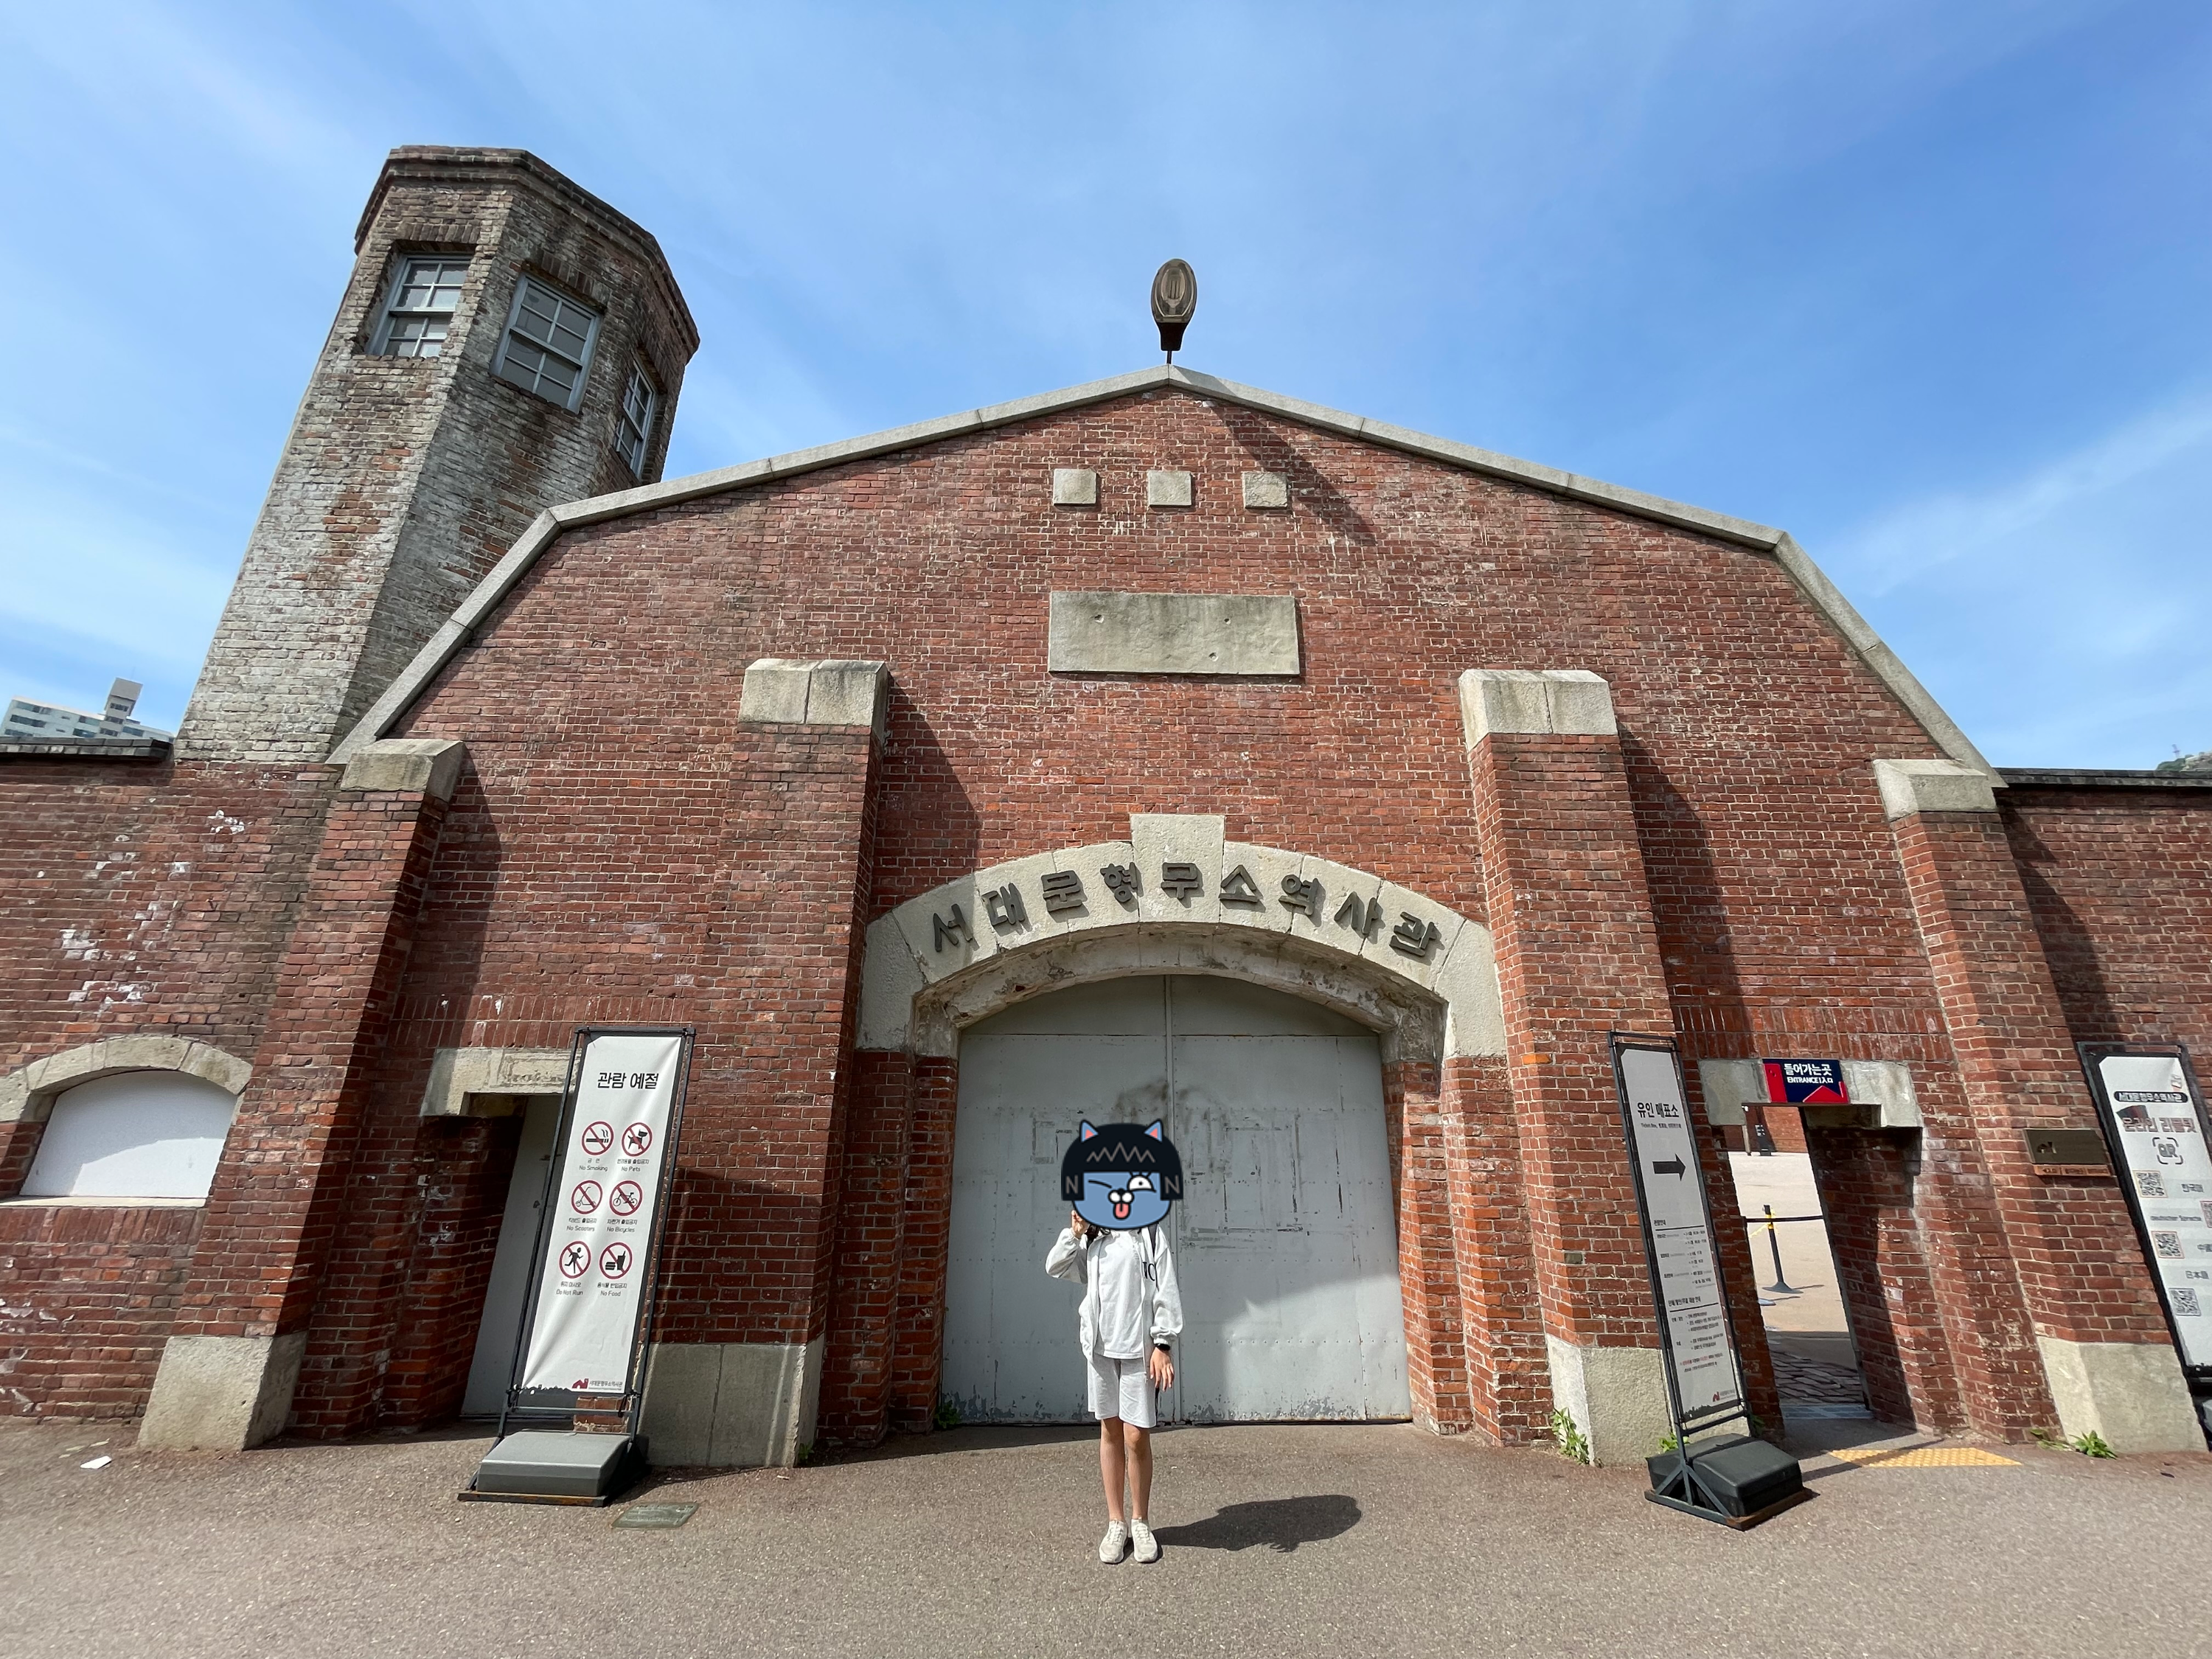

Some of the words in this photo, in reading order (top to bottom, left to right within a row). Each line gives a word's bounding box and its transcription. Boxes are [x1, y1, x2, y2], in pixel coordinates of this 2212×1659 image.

[933, 861, 1436, 957] 서대문형무소역사관
[1784, 1063, 1832, 1076] 들어가는곳
[597, 1072, 627, 1089] 관람
[630, 1073, 659, 1089] 예절
[1637, 1102, 1655, 1119] 유인
[2122, 1118, 2158, 1133] 온라인
[2157, 1144, 2179, 1158] QR
